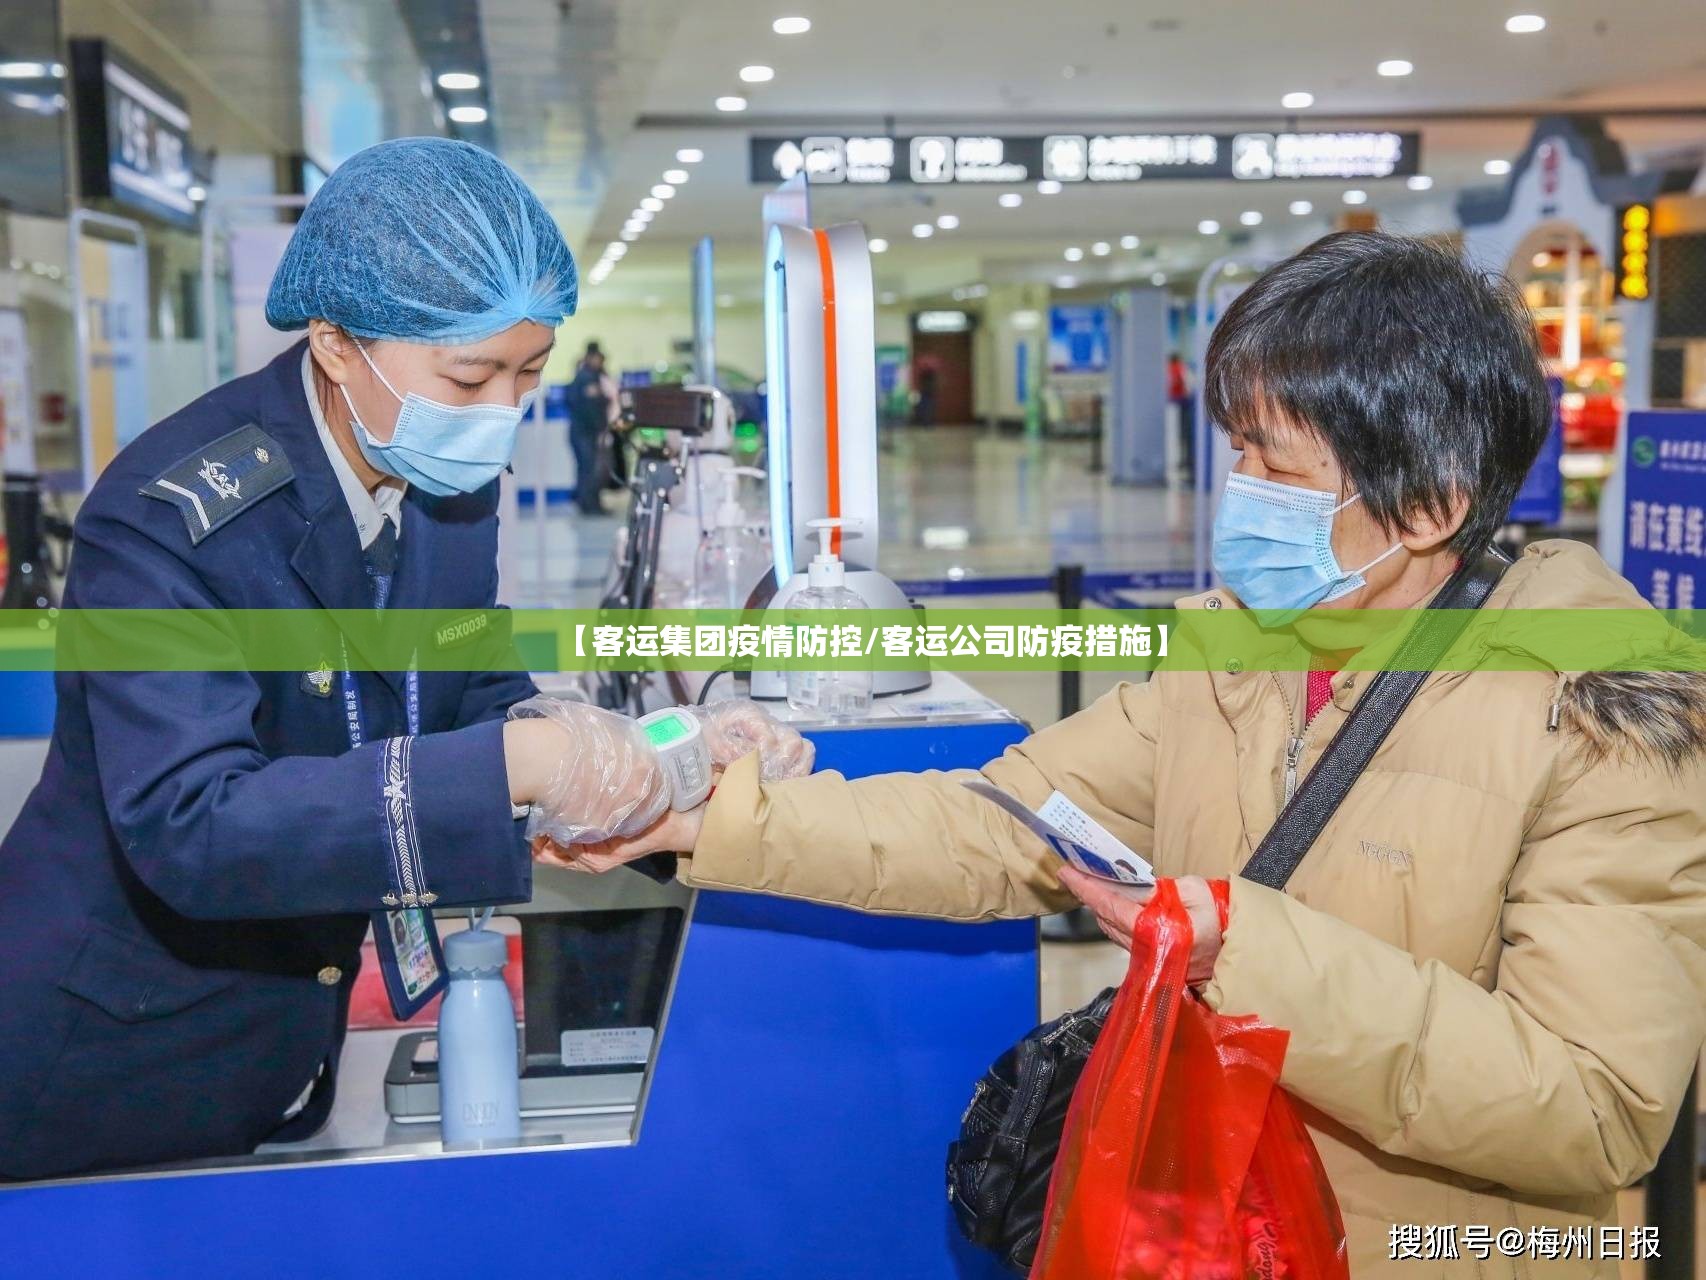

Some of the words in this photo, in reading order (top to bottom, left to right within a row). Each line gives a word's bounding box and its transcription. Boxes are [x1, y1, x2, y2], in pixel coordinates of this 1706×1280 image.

[1630, 500, 1706, 557] 请在黄线
[437, 614, 487, 645] MSX0039
